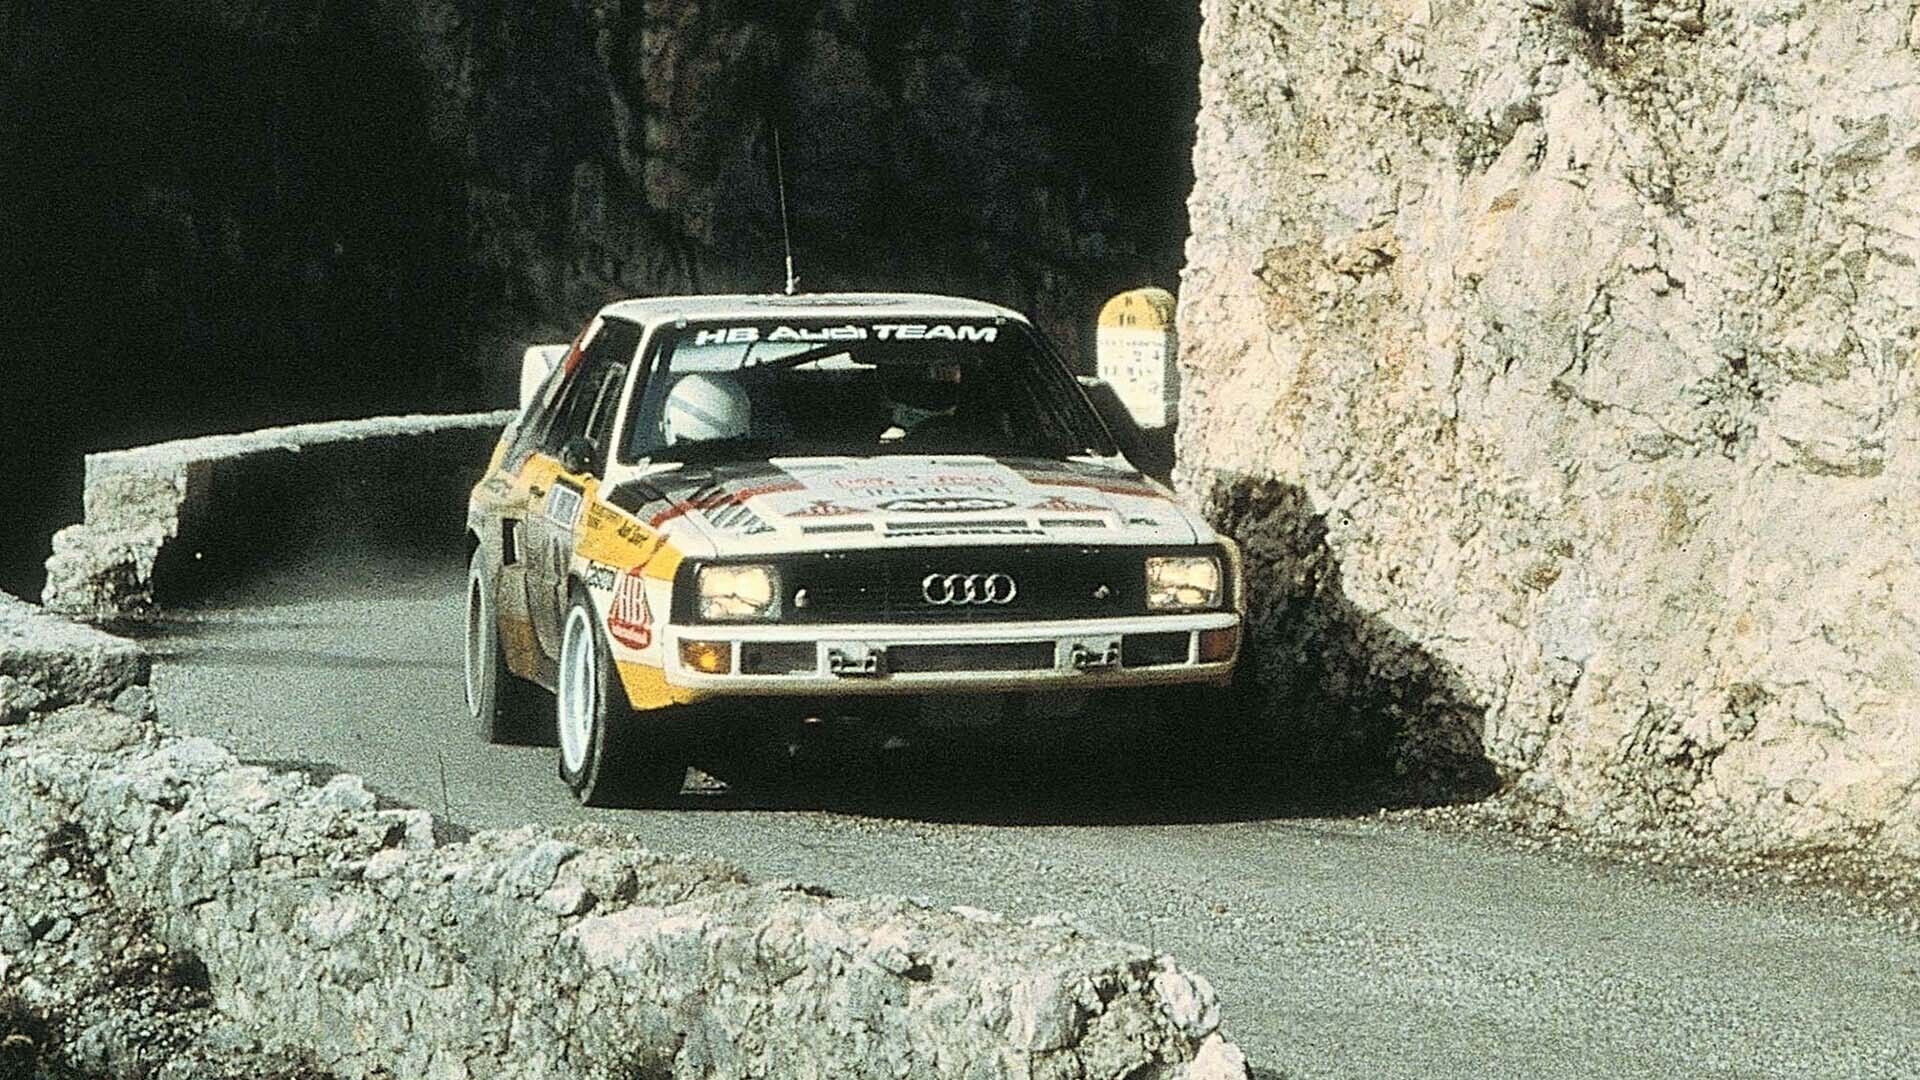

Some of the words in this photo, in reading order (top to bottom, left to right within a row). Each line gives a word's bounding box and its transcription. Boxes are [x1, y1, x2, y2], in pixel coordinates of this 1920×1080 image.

[695, 327, 759, 345] HB
[872, 324, 998, 342] TEAM
[883, 529, 1046, 538] MICHELIN
[612, 572, 648, 622] HB
